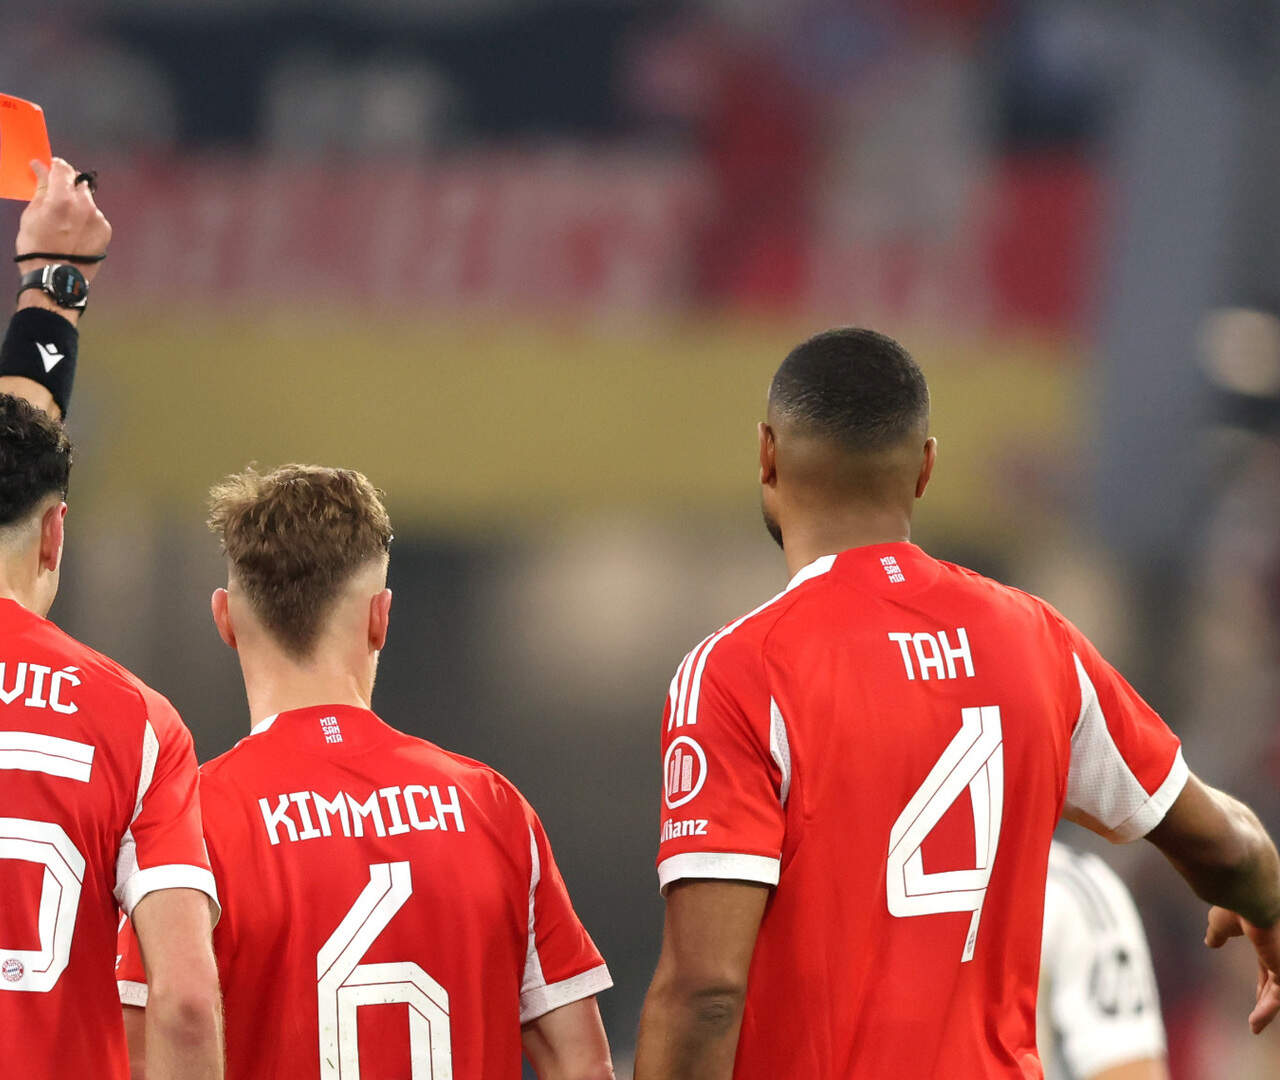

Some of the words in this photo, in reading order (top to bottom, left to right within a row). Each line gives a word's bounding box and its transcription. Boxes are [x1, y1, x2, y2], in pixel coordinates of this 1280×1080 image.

[888, 627, 976, 681] TAH
[320, 716, 338, 727] MIA
[325, 734, 343, 744] MIA
[258, 785, 466, 846] KIMMICH
[660, 818, 709, 843] llianz
[886, 705, 1004, 963] 4
